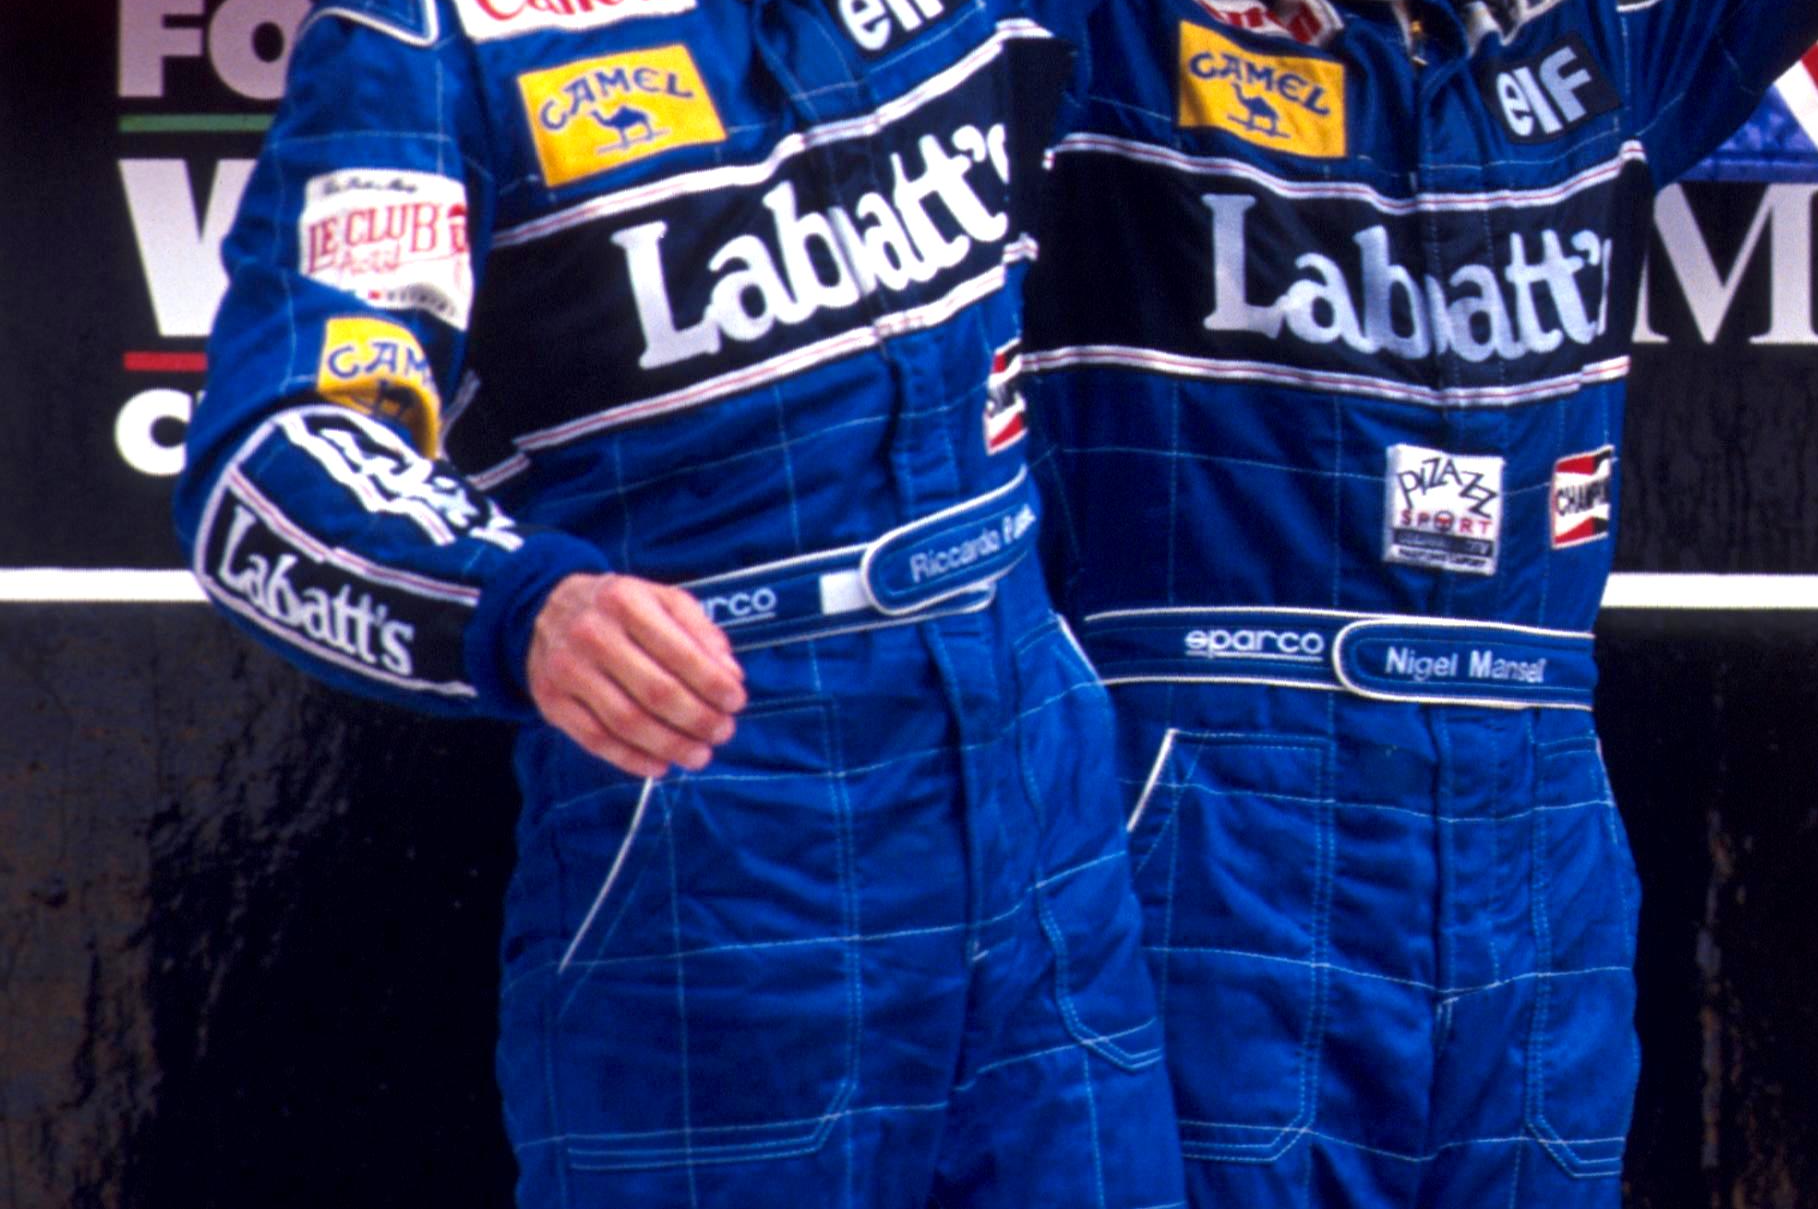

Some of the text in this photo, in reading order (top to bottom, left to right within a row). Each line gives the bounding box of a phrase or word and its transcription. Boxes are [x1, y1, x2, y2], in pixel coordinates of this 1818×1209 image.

[539, 67, 694, 131] CAMEL
[1189, 51, 1331, 116] CAMEL
[1496, 46, 1592, 136] elf
[344, 202, 439, 253] CLUB
[910, 527, 1000, 582] Riccardo
[218, 504, 415, 669] Labatt's
[1184, 630, 1325, 658] sparco
[1386, 646, 1458, 682] Nigel
